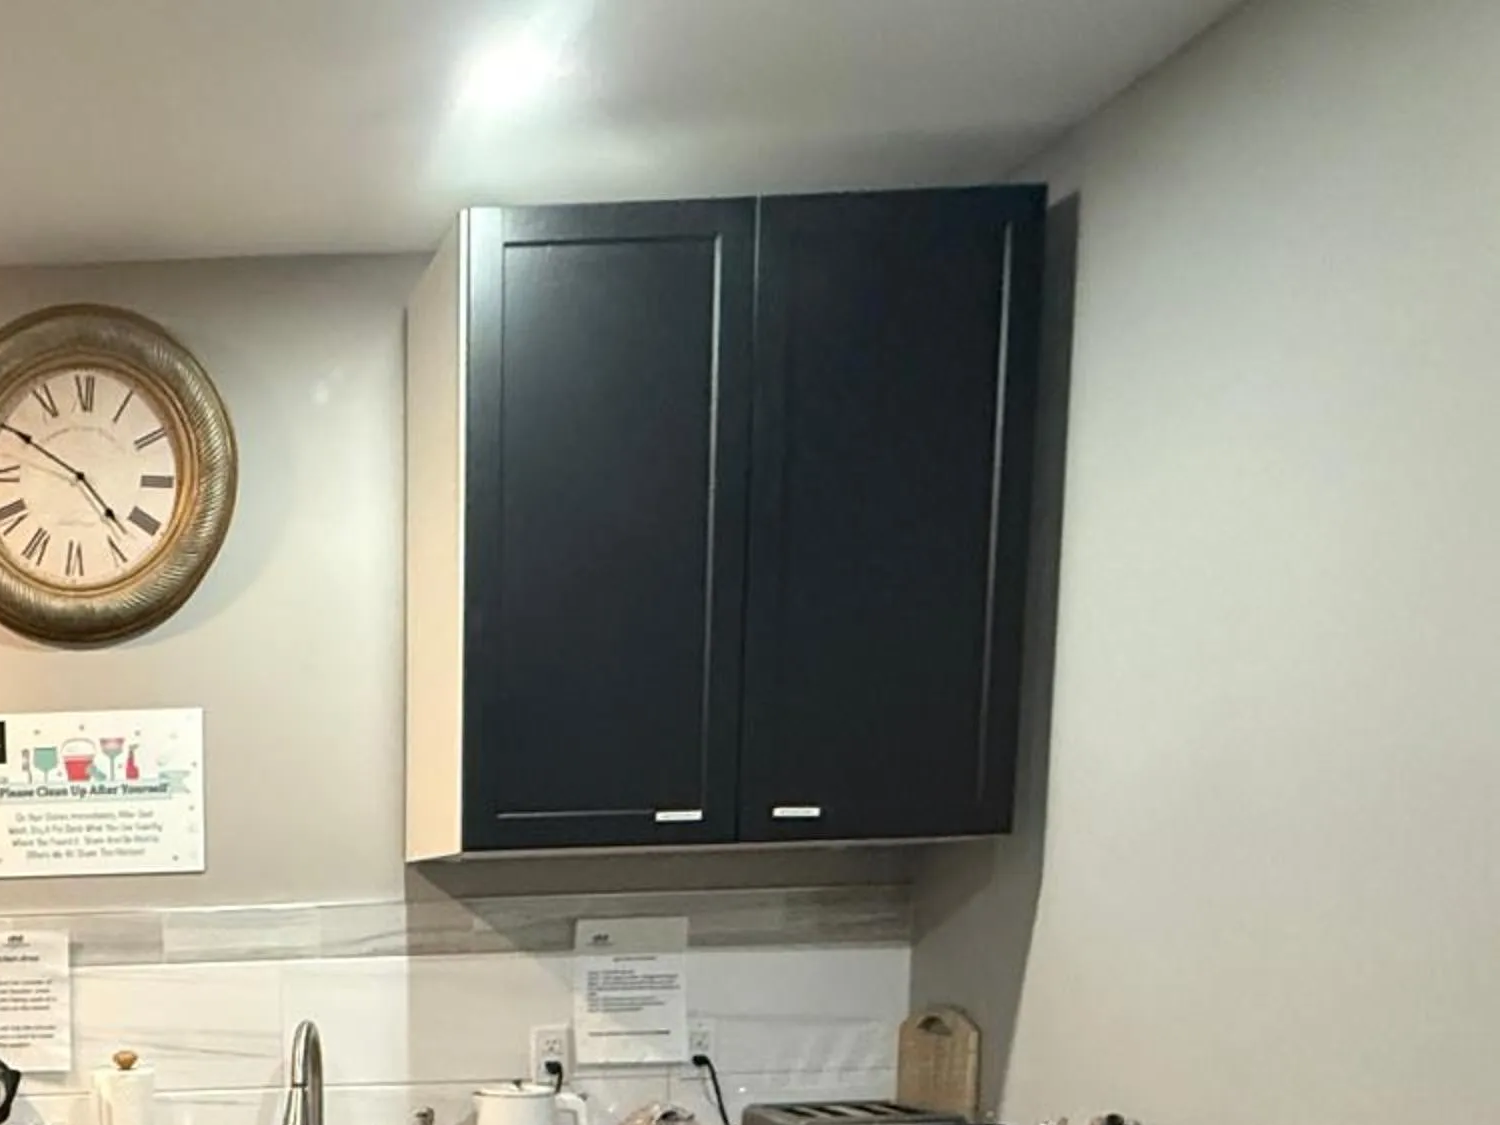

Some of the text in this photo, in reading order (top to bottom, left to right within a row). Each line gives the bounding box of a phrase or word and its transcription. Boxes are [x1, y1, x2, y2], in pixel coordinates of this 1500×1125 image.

[36, 785, 68, 797] Clean
[70, 785, 87, 799] Up
[90, 784, 117, 796] After
